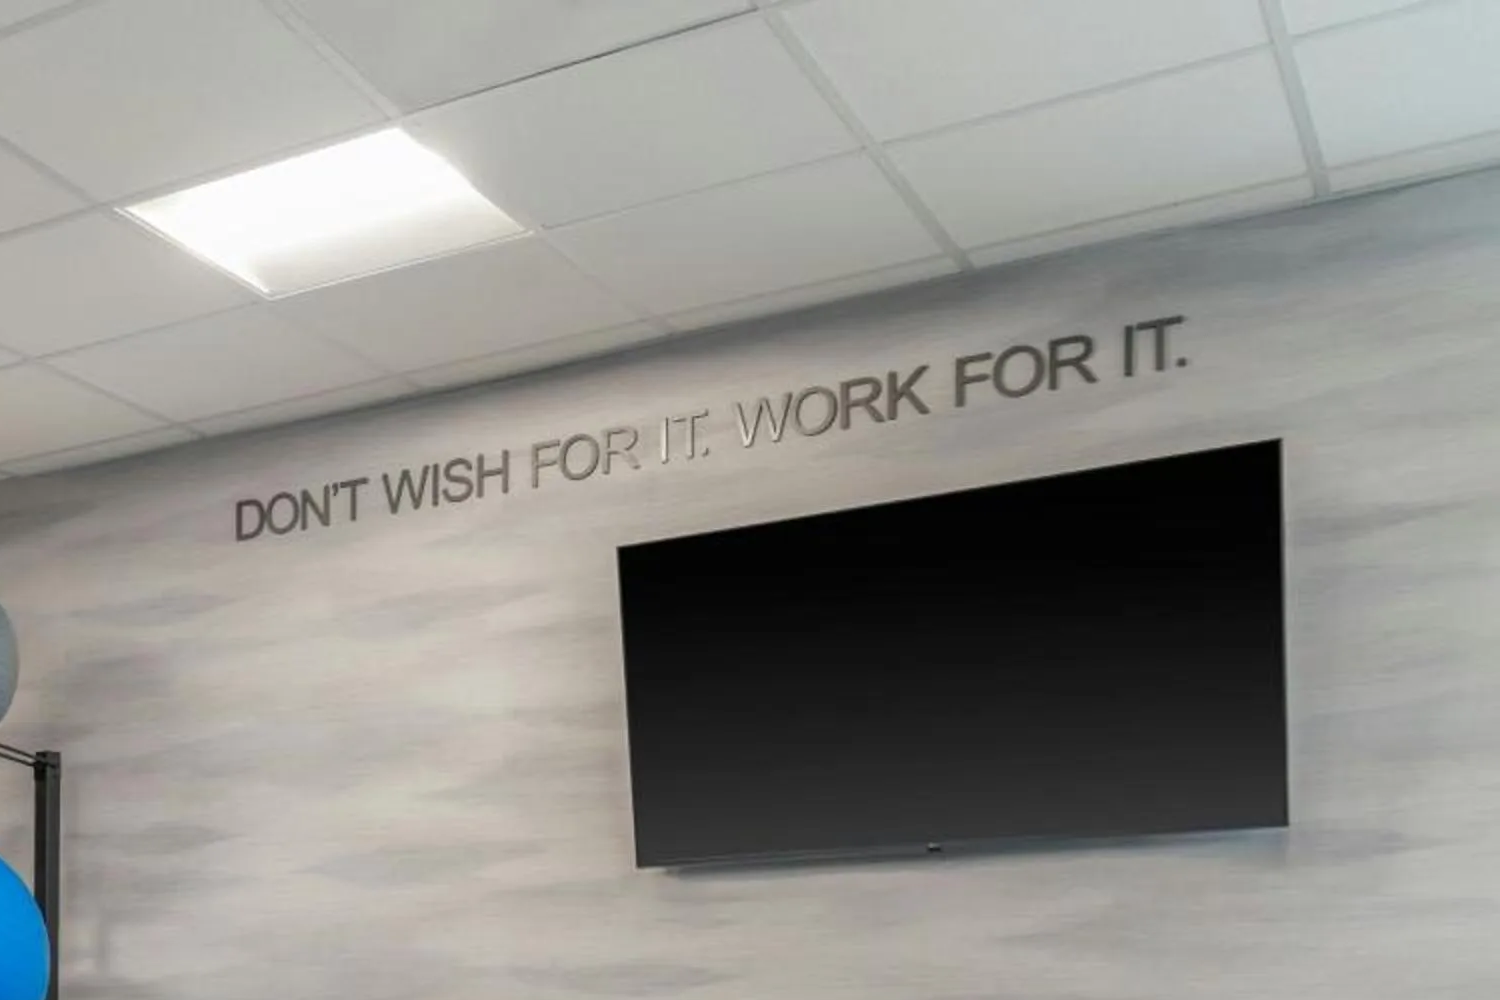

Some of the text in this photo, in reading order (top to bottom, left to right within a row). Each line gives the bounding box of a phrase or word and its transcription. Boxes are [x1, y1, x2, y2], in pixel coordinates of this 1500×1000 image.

[235, 314, 1188, 542] DON'T WISH FOR IT. WORK FOR IT.
